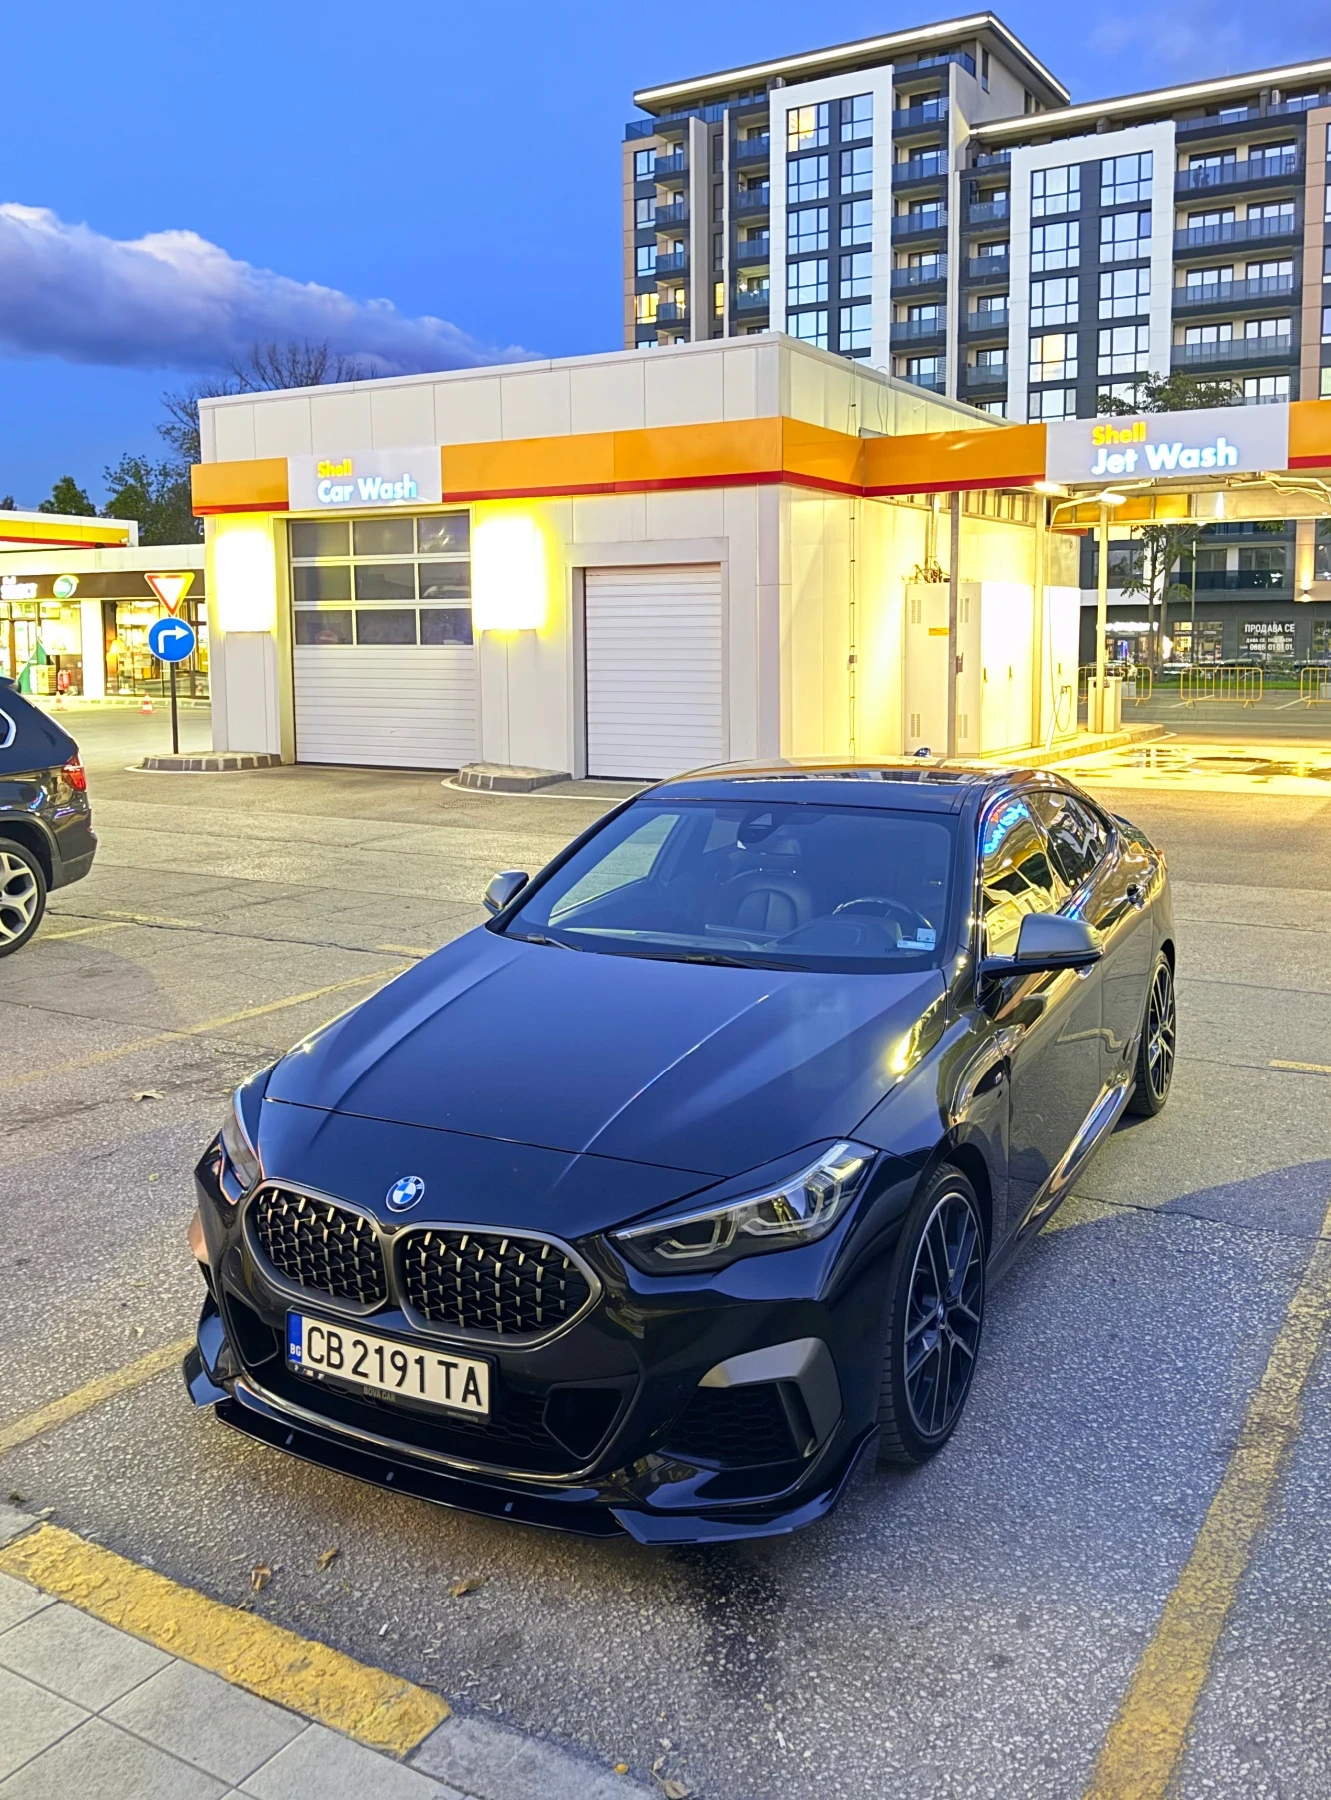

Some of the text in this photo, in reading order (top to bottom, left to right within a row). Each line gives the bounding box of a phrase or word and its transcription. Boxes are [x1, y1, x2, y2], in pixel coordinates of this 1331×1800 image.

[1091, 421, 1146, 446] Shell
[1091, 437, 1238, 475] Jet Wash
[317, 458, 352, 478] Shell
[317, 473, 417, 503] Car Wash
[1244, 623, 1295, 633] ПРОДАВА СЕ
[289, 1343, 302, 1357] BG
[381, 1389, 396, 1403] CAR
